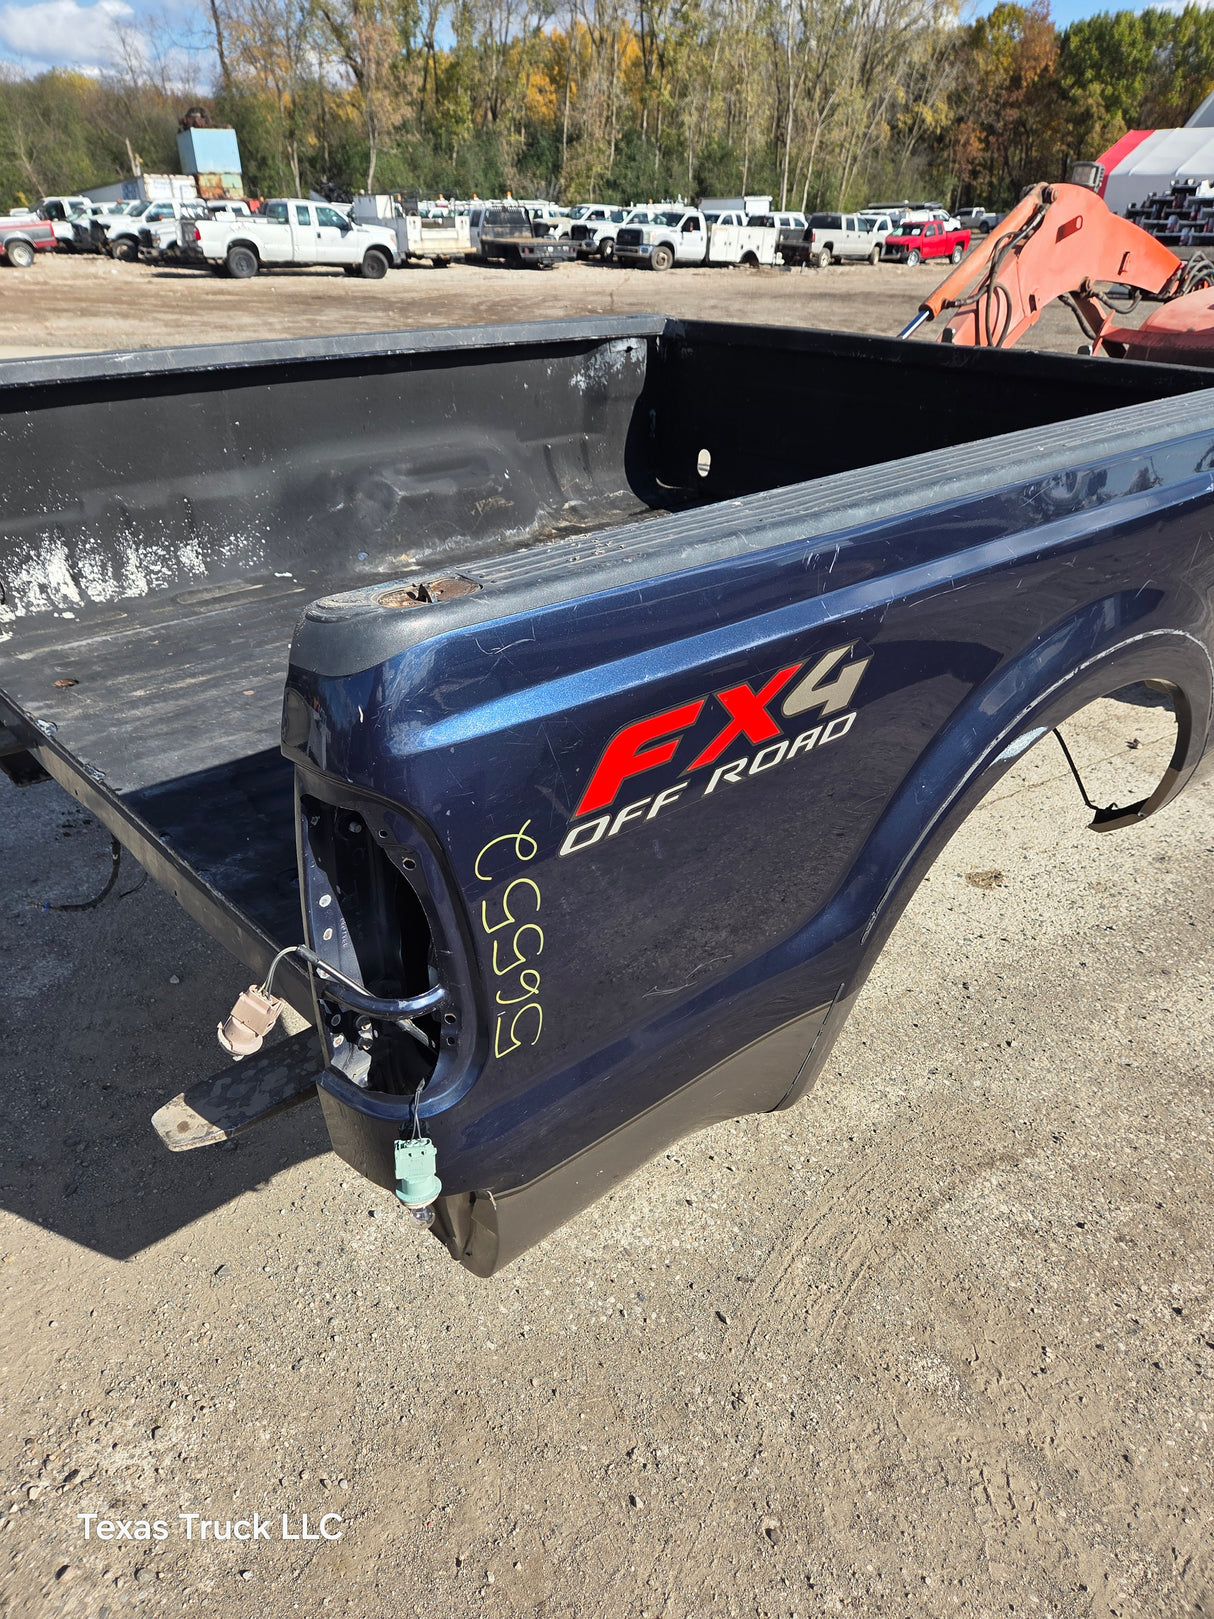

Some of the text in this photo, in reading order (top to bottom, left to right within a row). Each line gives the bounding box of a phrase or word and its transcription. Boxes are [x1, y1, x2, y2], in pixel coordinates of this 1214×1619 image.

[558, 711, 858, 857] OFF ROAD
[573, 643, 871, 818] FX4
[474, 818, 545, 1059] 56552
